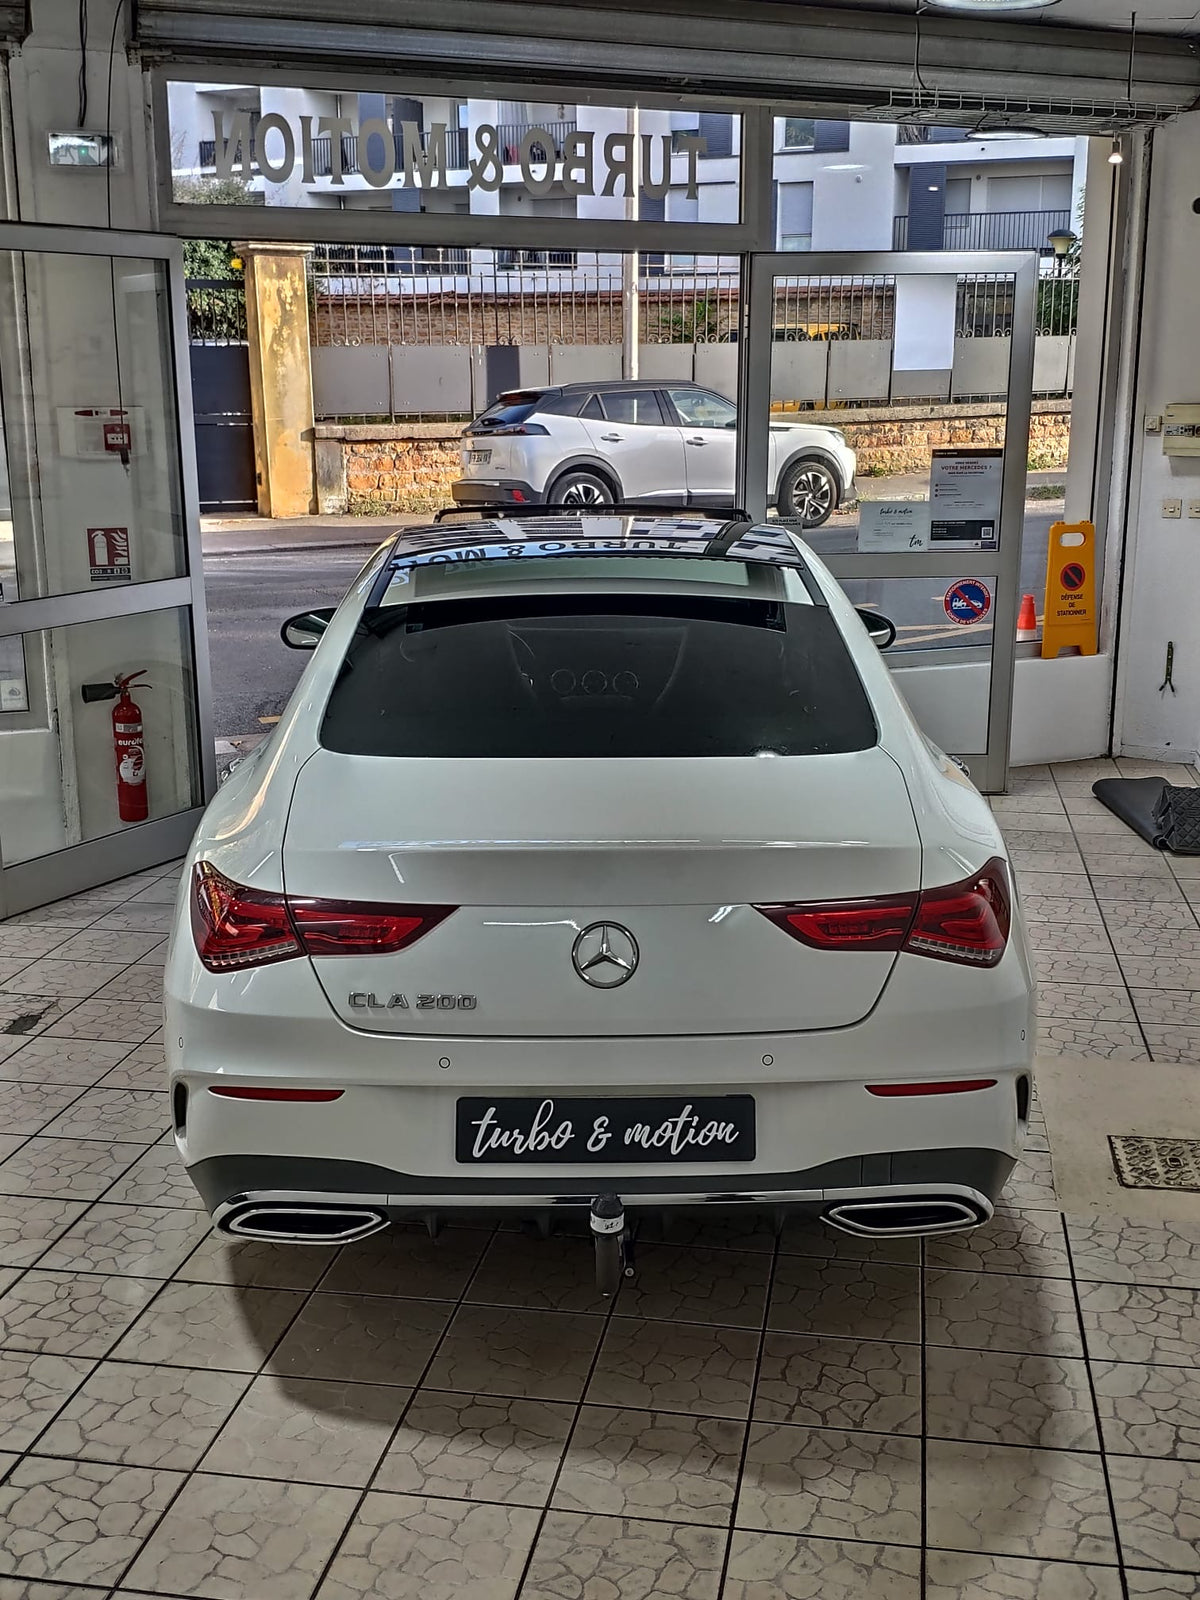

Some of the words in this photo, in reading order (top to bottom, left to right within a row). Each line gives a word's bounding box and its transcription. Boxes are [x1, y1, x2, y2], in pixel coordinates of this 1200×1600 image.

[945, 580, 976, 600] STATIONNEMENT
[975, 581, 990, 598] INTERDIT
[1060, 592, 1084, 600] DÉFENSE
[947, 609, 960, 622] SORTIE
[1056, 609, 1087, 617] STATIONNER
[348, 992, 410, 1009] CLA
[415, 993, 477, 1010] 200
[471, 1099, 575, 1158] turbo
[586, 1116, 612, 1152] &
[624, 1104, 739, 1156] motion
